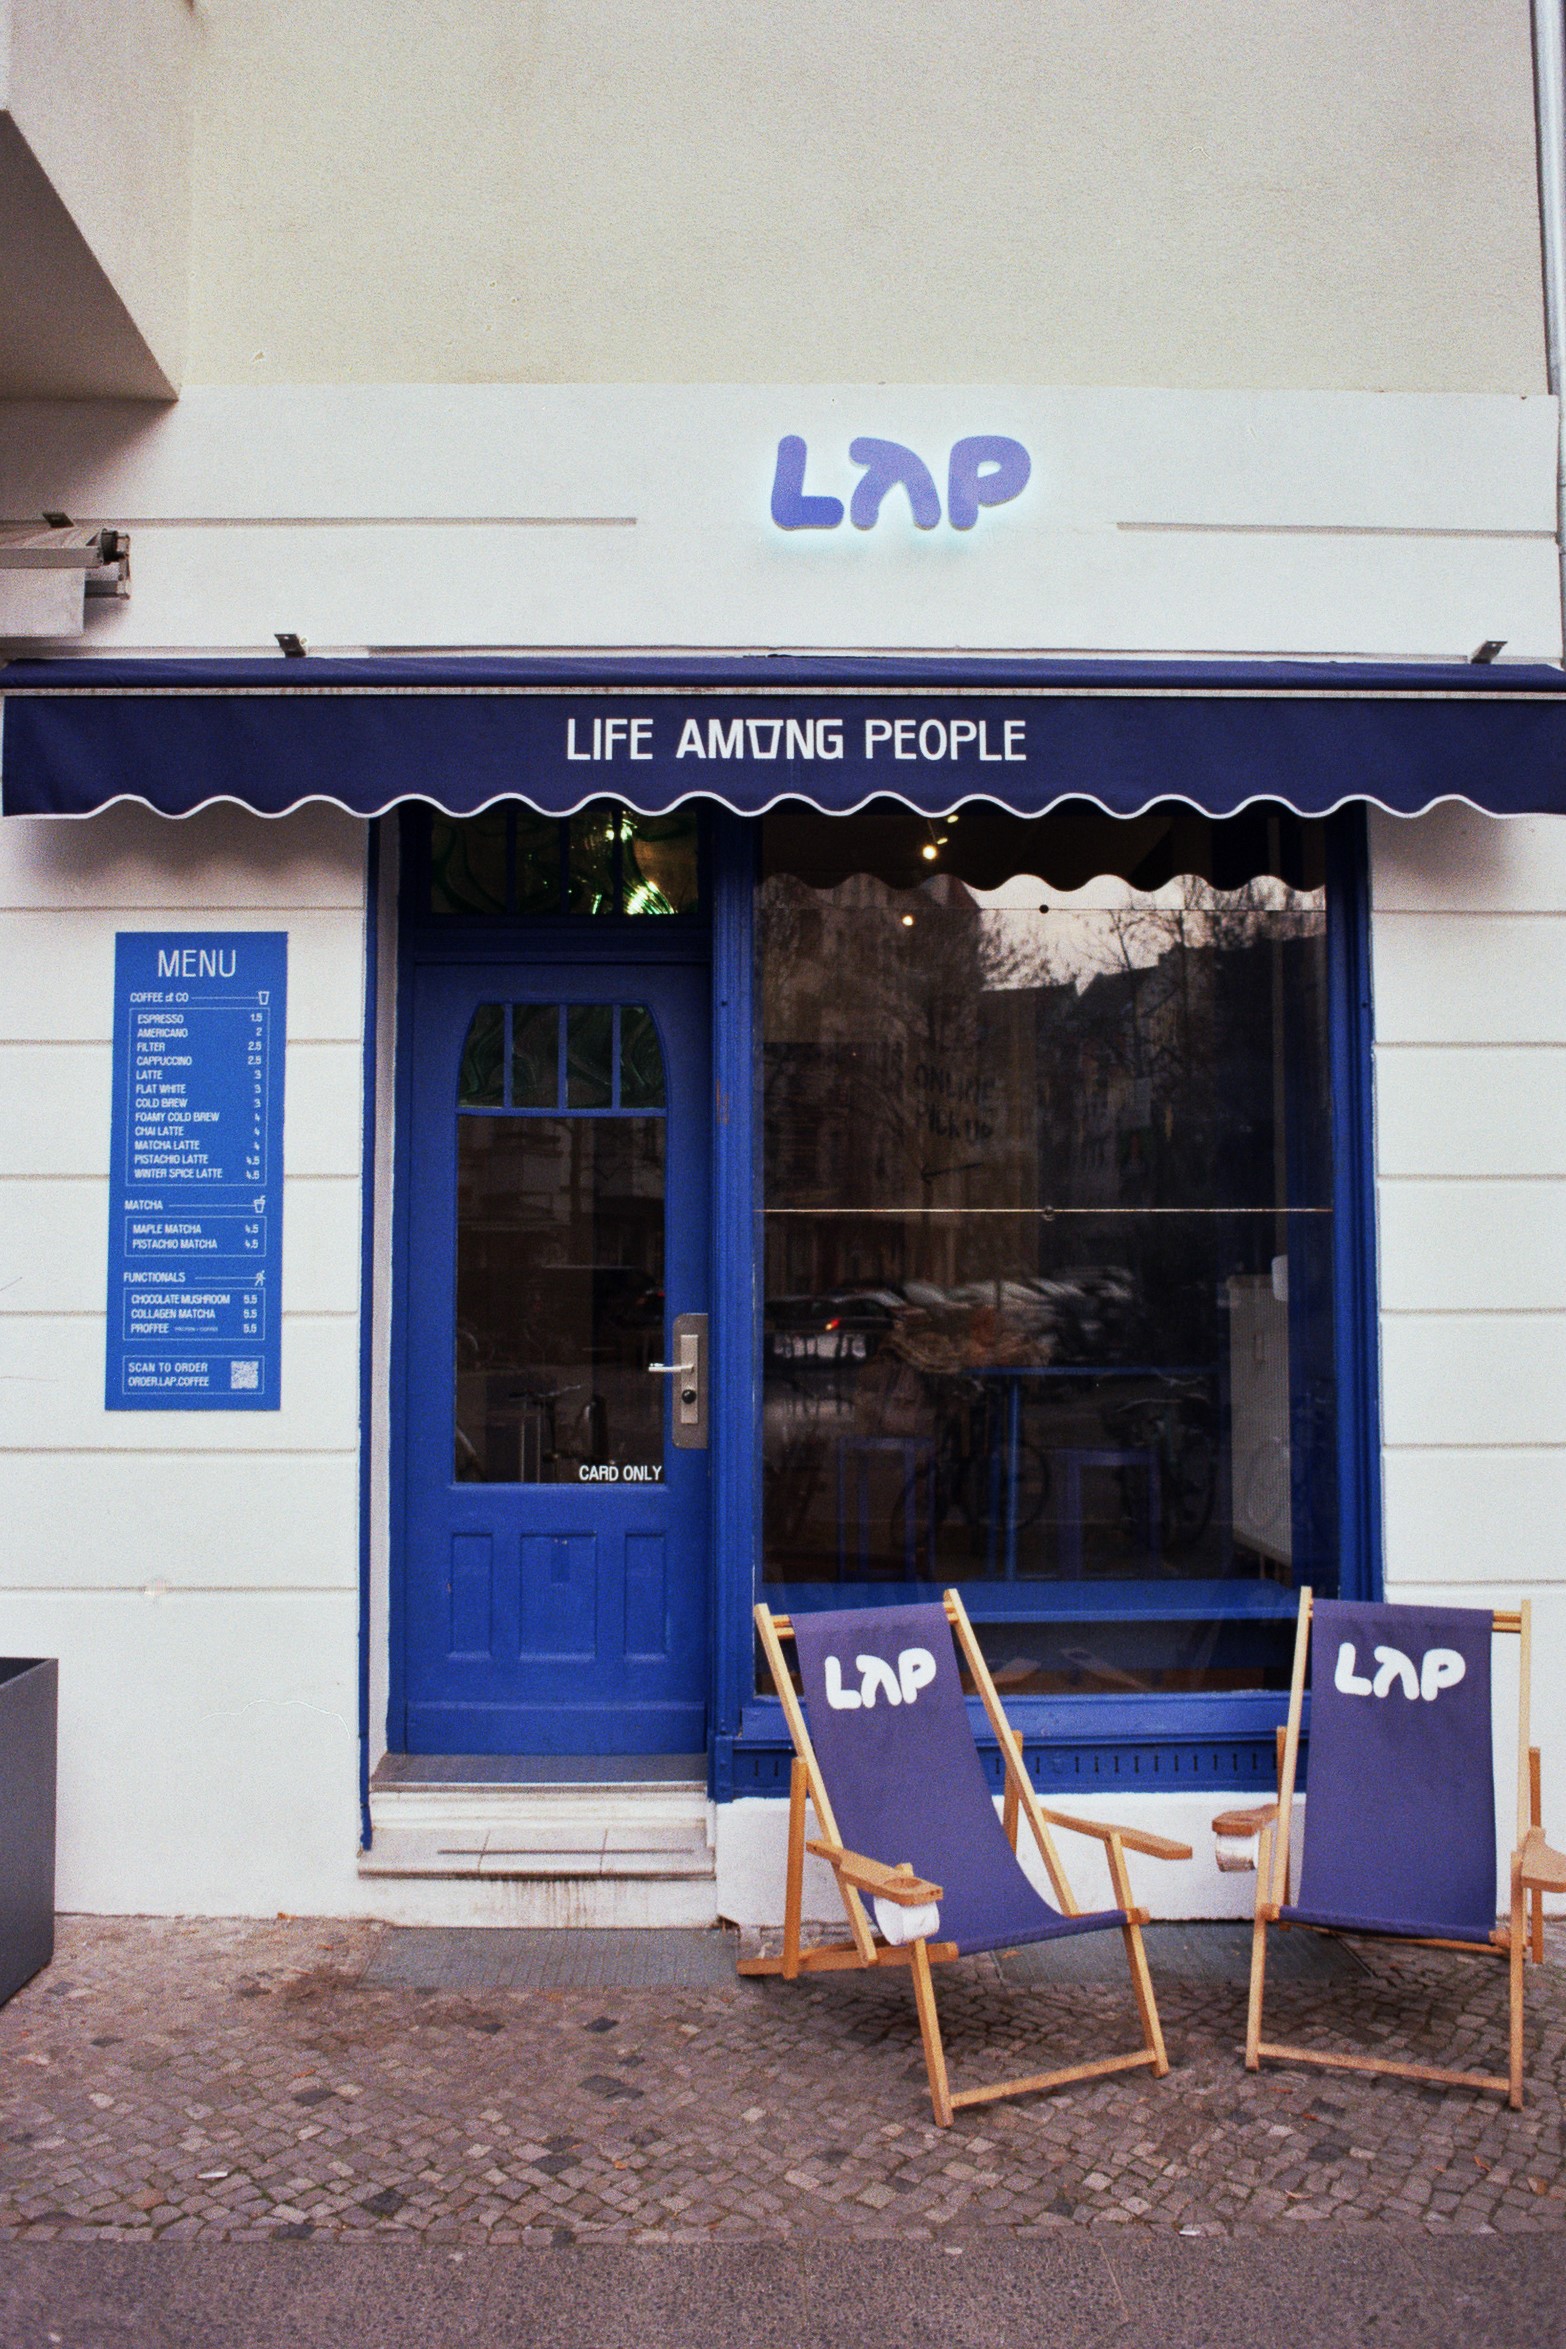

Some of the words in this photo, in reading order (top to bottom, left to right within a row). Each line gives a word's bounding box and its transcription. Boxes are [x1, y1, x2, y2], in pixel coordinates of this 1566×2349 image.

[770, 434, 1032, 531] LAP
[567, 718, 653, 760] LIFE
[676, 718, 843, 759] AMONG
[865, 720, 1027, 761] PEOPLE
[158, 949, 237, 977] MENU
[130, 993, 163, 1002] COFFEE
[175, 993, 189, 1002] CO
[138, 1015, 184, 1024] ESPRESSO
[137, 1028, 188, 1038] AMERICANO
[256, 1028, 262, 1037] 2
[137, 1042, 165, 1052] FILTER
[248, 1041, 262, 1051] 2.5
[137, 1056, 192, 1066] CAPPUCCINO
[136, 1070, 162, 1079] LATTE
[255, 1070, 261, 1079] 3
[136, 1084, 157, 1093] FLAT
[159, 1084, 186, 1093] WHITE
[255, 1084, 261, 1093] 3
[136, 1098, 159, 1107] COLD
[162, 1098, 187, 1107] BREW
[255, 1098, 261, 1108] 3
[135, 1112, 165, 1122] FOAMY
[168, 1112, 191, 1122] COLD
[193, 1112, 219, 1122] BREW
[135, 1126, 155, 1136] CHAI
[158, 1126, 183, 1136] LATTE
[135, 1141, 171, 1150] MATCHA
[174, 1141, 200, 1150] LATTE
[135, 1154, 181, 1164] PISTACHIO
[182, 1154, 208, 1164] LATTE
[135, 1169, 167, 1178] WINTER
[170, 1169, 193, 1178] SPICE
[196, 1169, 222, 1178] LATTE
[125, 1200, 163, 1210] MATCHA
[133, 1224, 162, 1234] MAPLE
[164, 1224, 201, 1234] MATCHA
[133, 1239, 178, 1249] PISTACHIO
[181, 1239, 217, 1249] MATCHA
[123, 1273, 186, 1282] FUNCTIONALS
[132, 1295, 180, 1304] CHOCOLATE
[181, 1295, 230, 1304] MUSHROOM
[131, 1309, 176, 1318] COLLAGEN
[178, 1309, 215, 1318] MATCHA
[131, 1324, 169, 1333] PROFFEE
[129, 1363, 155, 1372] SCAN
[159, 1363, 170, 1372] TO
[175, 1363, 208, 1372] ORDER
[579, 1464, 619, 1481] CARD
[623, 1464, 662, 1481] ONLY
